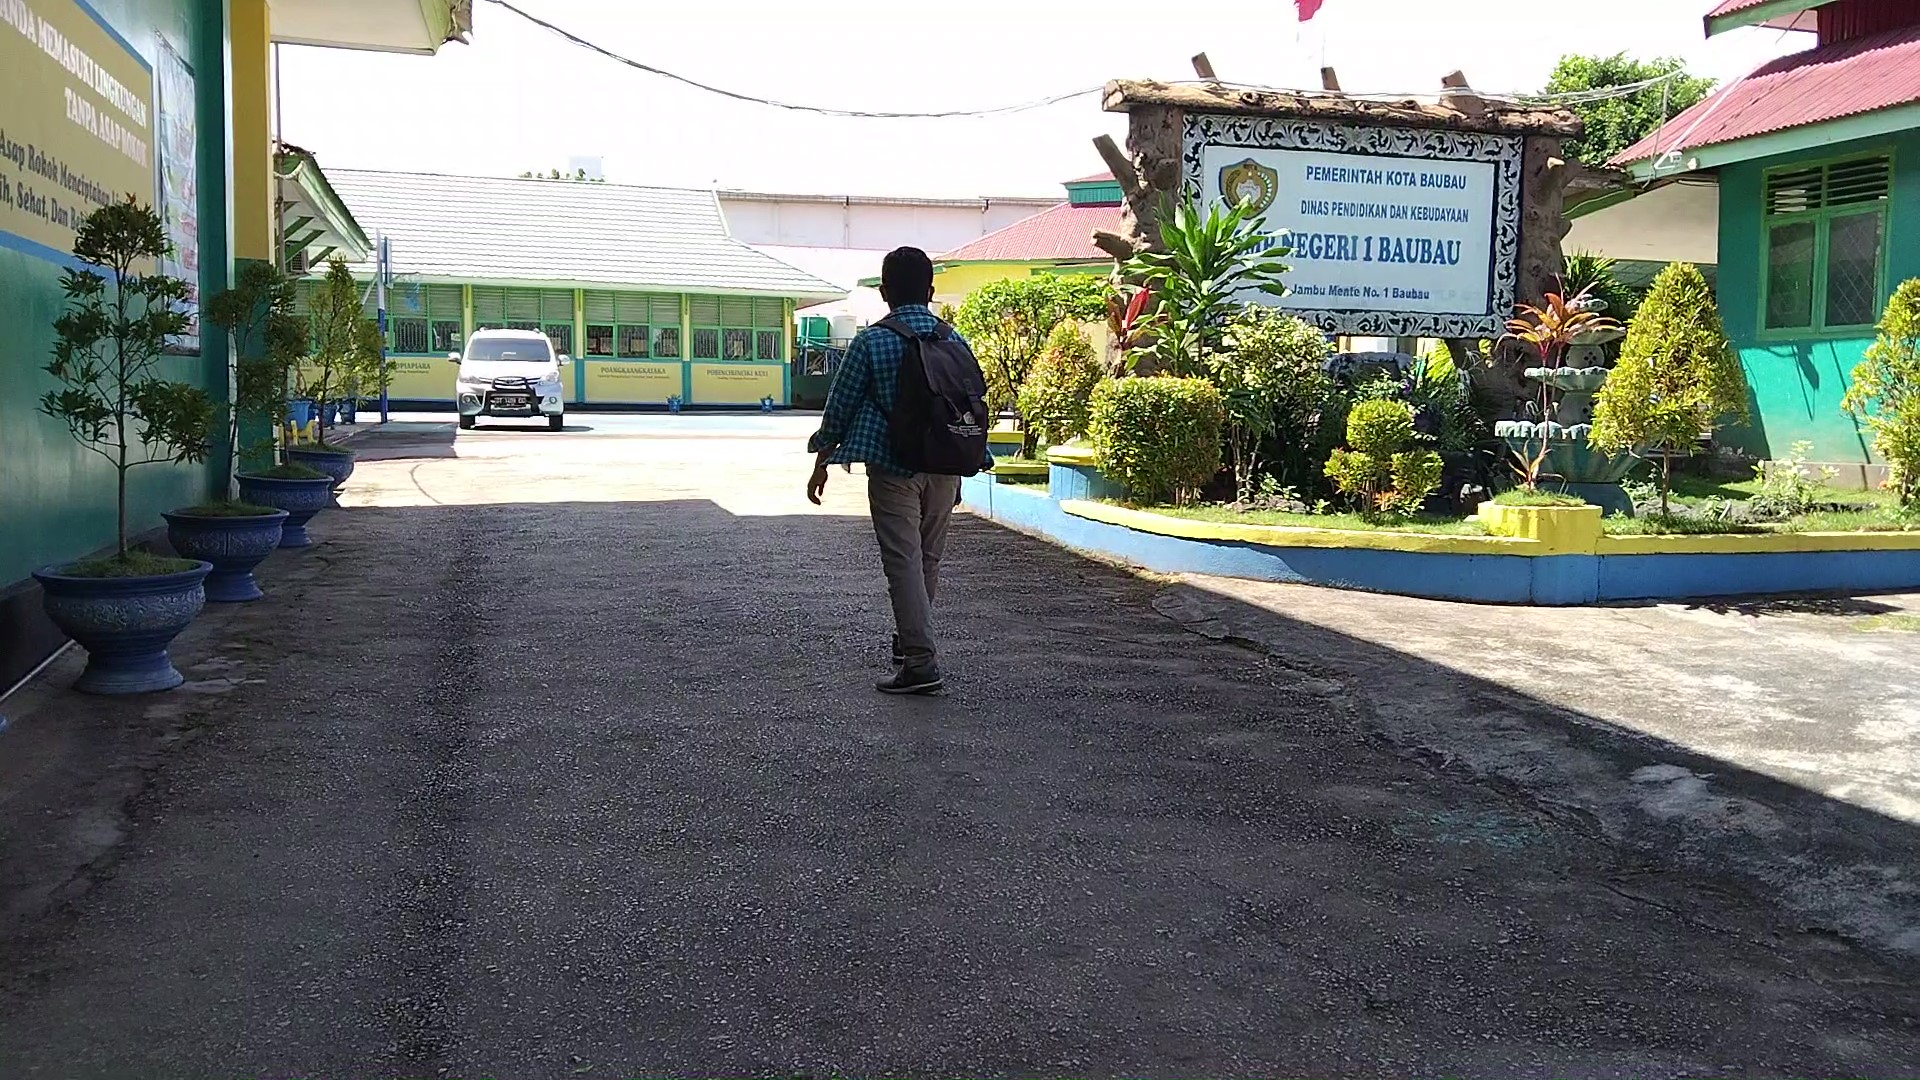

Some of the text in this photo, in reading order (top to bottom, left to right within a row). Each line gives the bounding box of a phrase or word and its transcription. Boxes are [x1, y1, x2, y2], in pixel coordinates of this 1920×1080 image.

[37, 15, 94, 89] MEMASUKI
[94, 63, 147, 130] LINGKUNGAN
[64, 86, 98, 137] TANPA
[99, 111, 121, 150] ASAP
[0, 127, 25, 172] Asap
[27, 143, 58, 184] Rokok
[1305, 165, 1467, 190] PEMERINTAH KOTA BAUBAU
[17, 181, 49, 226] Sehat,
[51, 197, 68, 228] Dan
[1300, 199, 1469, 223] DINAS PENDIDIKAN DAN KEBUDAYAAN
[1281, 231, 1359, 262] NEGERI
[1362, 235, 1373, 263] 1
[1378, 236, 1462, 266] BAUBAU
[1292, 284, 1326, 296] Jambu
[1328, 285, 1361, 298] Mente
[1363, 286, 1380, 298] No.
[1383, 287, 1389, 298] 1
[1392, 287, 1430, 300] Baubau
